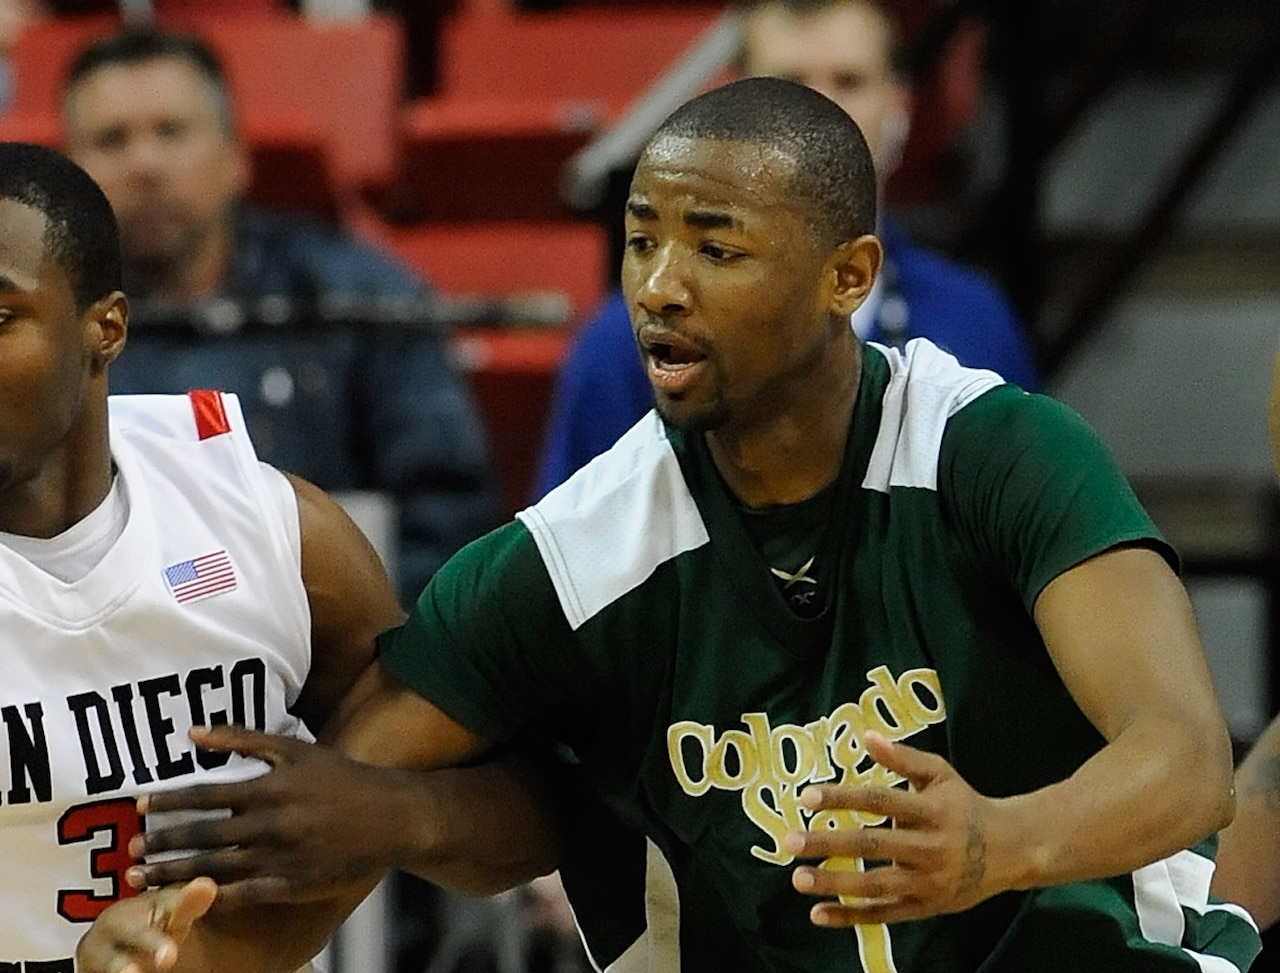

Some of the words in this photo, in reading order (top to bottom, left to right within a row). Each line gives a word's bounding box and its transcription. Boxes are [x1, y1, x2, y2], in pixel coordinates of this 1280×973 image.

[66, 657, 267, 796] DIEGO
[667, 665, 948, 797] Colorado
[56, 796, 147, 924] 3
